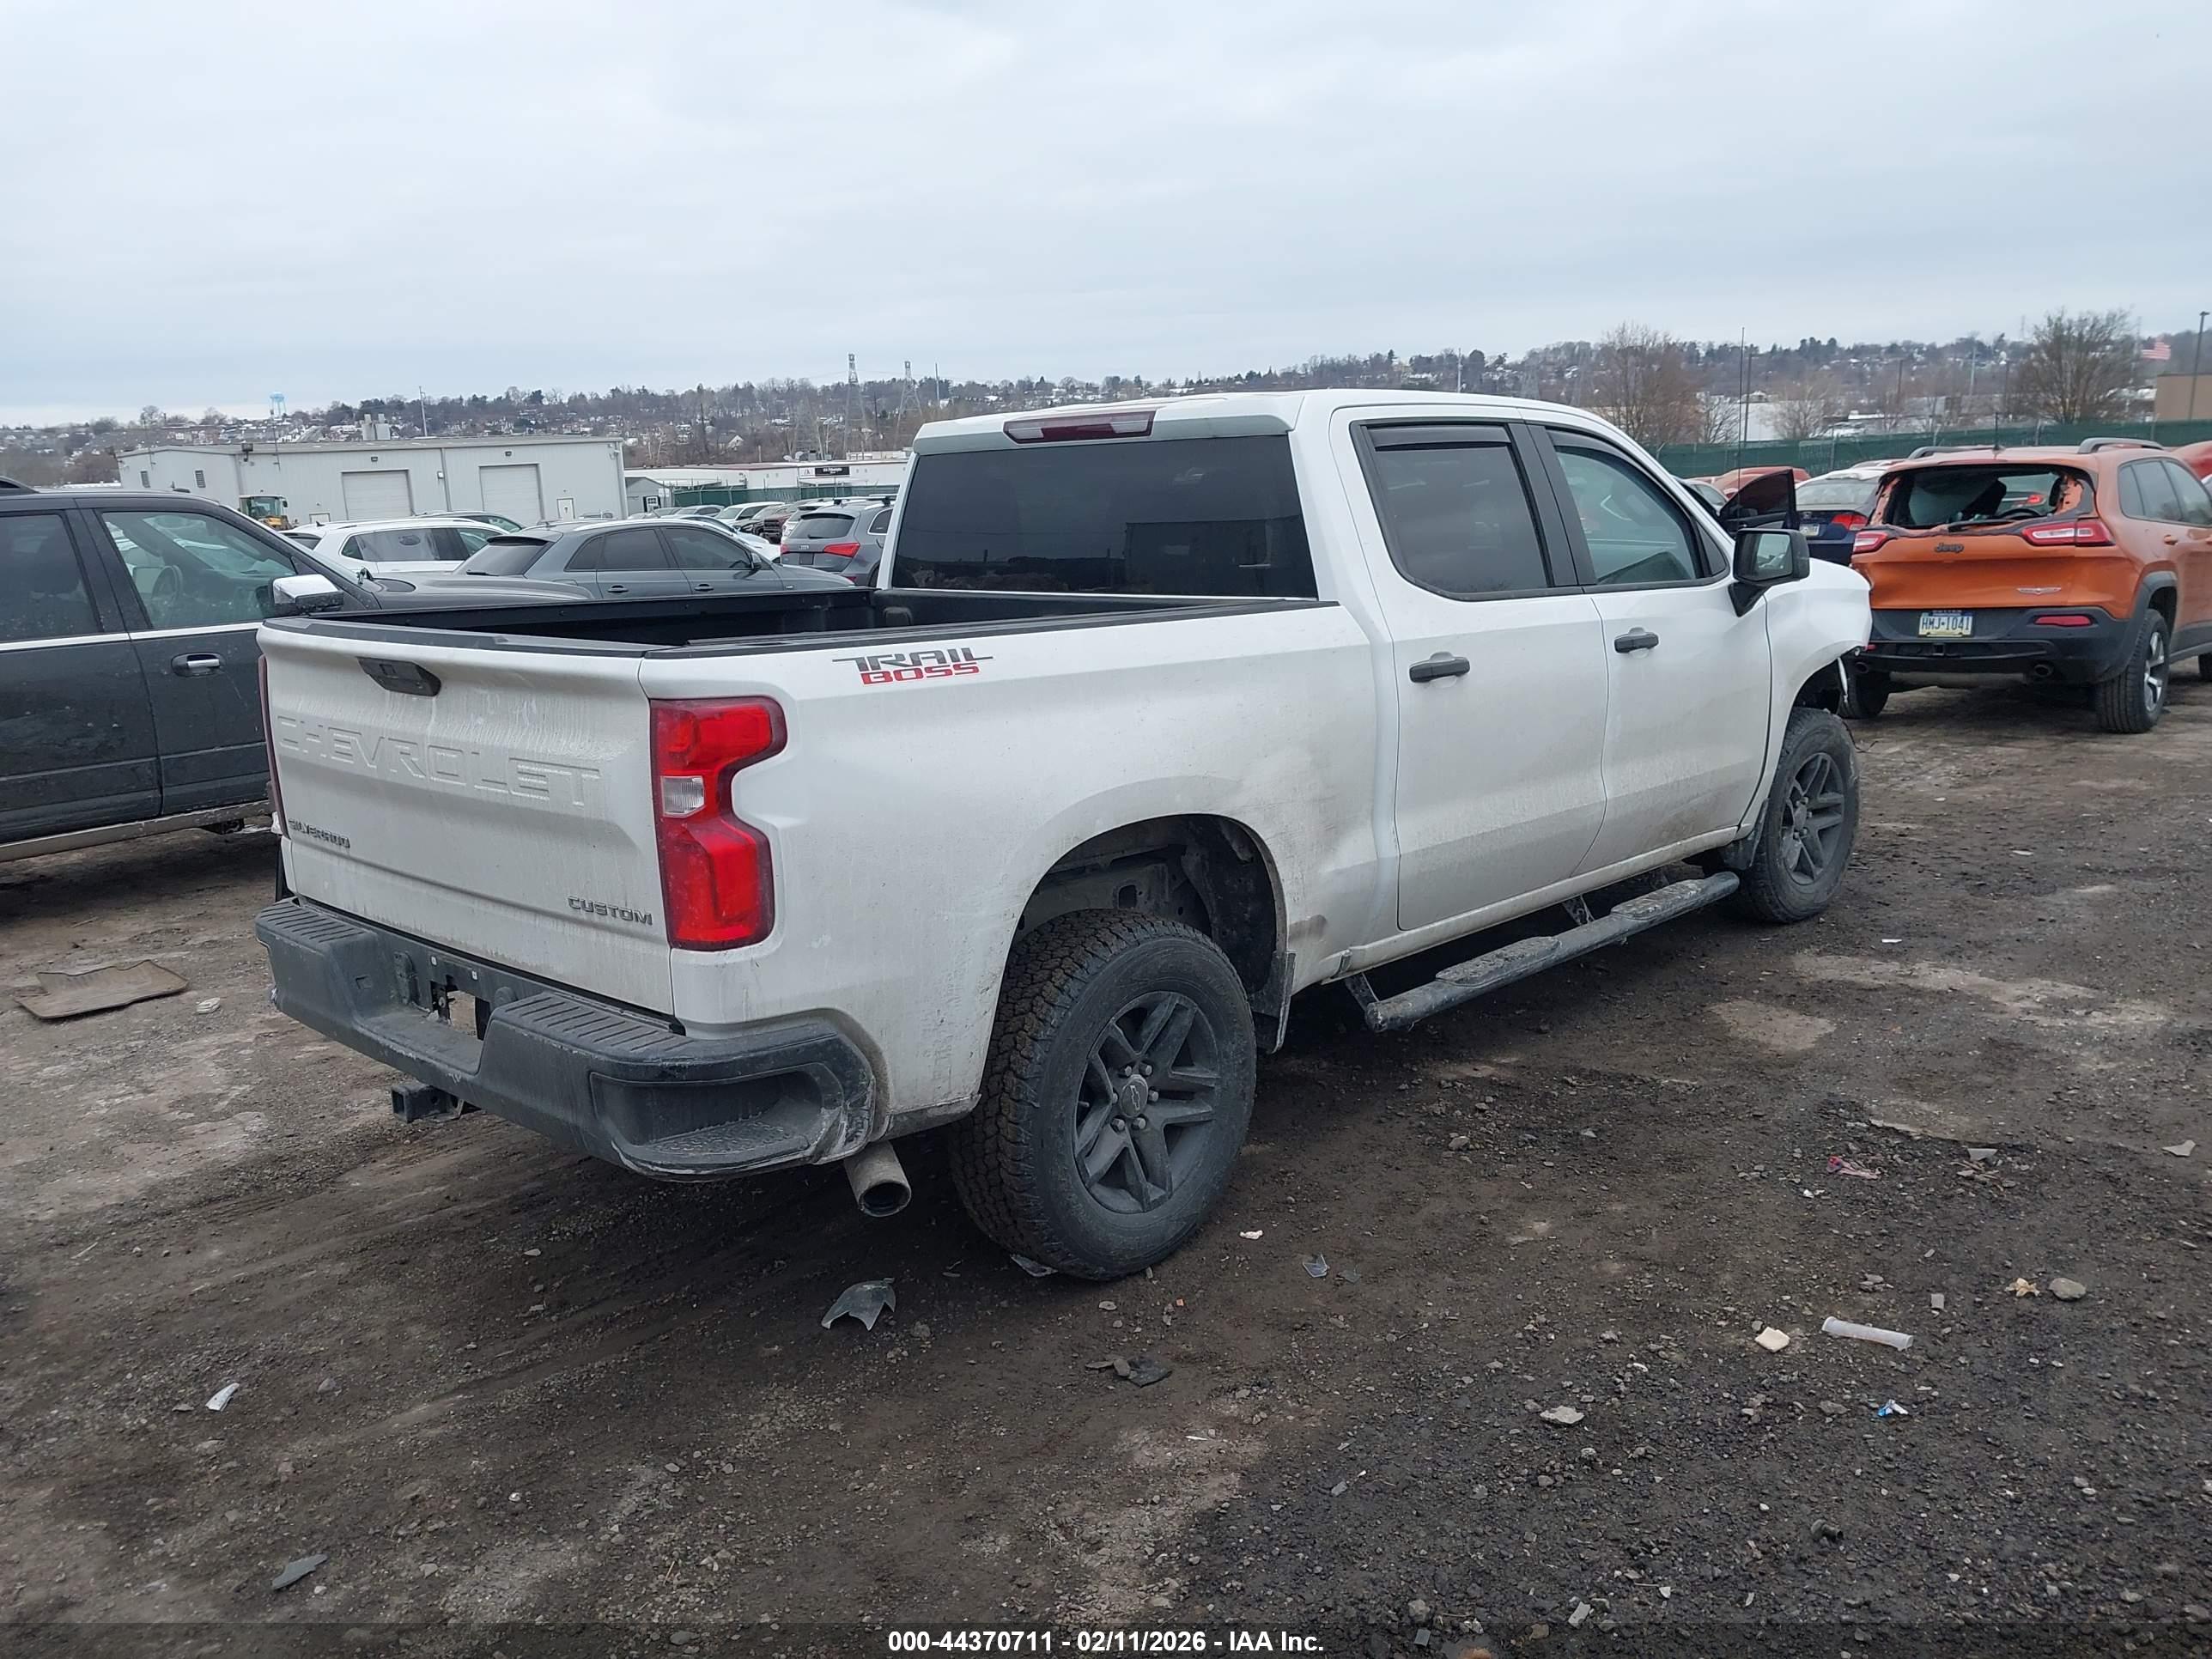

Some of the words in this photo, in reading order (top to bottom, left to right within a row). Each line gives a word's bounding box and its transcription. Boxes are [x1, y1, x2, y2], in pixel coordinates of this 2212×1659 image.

[832, 647, 994, 672] TRAIL
[860, 662, 980, 685] BOSS
[276, 714, 600, 807] CHEVROLET
[288, 818, 350, 848] SILVERADO
[568, 896, 653, 926] CUSTOM
